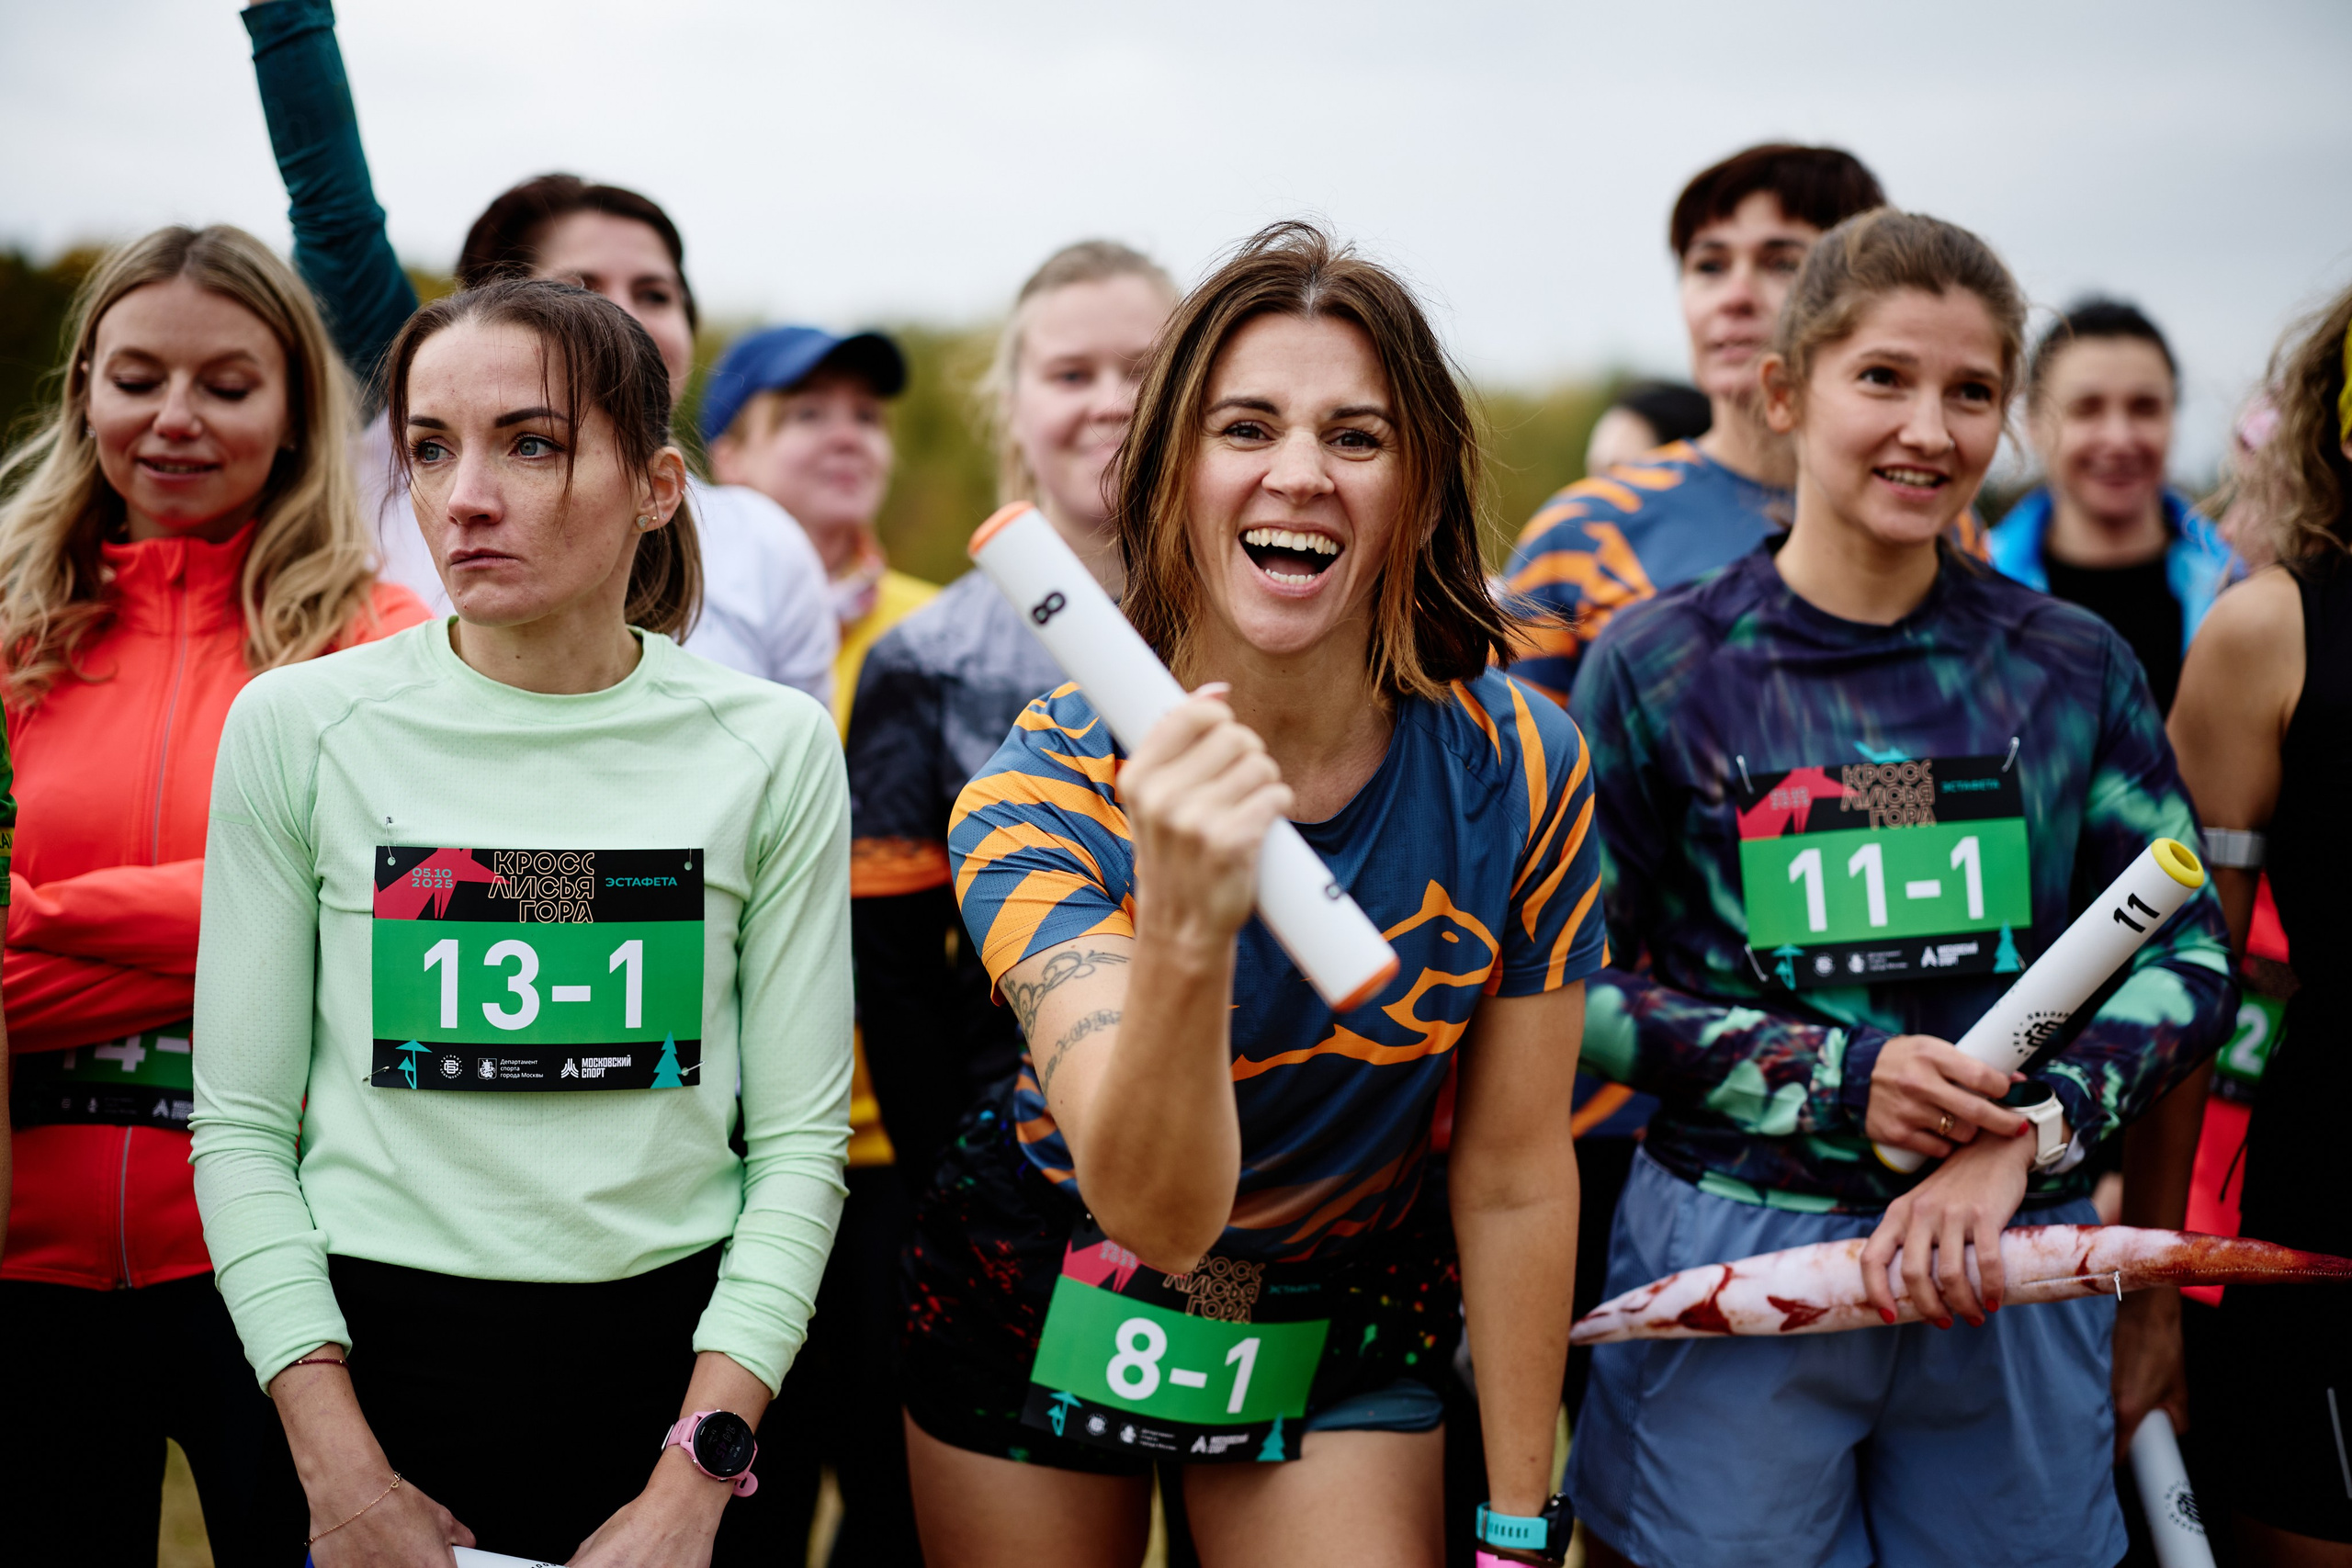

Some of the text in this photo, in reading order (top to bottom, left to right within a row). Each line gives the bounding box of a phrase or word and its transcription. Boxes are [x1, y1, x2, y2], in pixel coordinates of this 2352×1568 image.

[1032, 592, 1066, 626] 8
[1869, 804, 1937, 831] ГОРА
[412, 868, 452, 878] 05.10
[494, 852, 594, 875] КРОСС
[412, 878, 453, 888] 2025
[488, 876, 594, 899] ЛИСЬЯ
[605, 876, 678, 888] ЭСТАФЕТА
[1788, 836, 1984, 932] 11-1
[519, 900, 594, 923] ГОРА
[2113, 893, 2160, 933] 11
[424, 939, 643, 1031] 13-1
[582, 1055, 631, 1068] МОСКОВСКИЙ
[582, 1067, 605, 1078] СПОРТ
[1194, 1253, 1266, 1283] РОСС
[1185, 1294, 1252, 1325] ГОРА
[1106, 1317, 1261, 1415] 8-1
